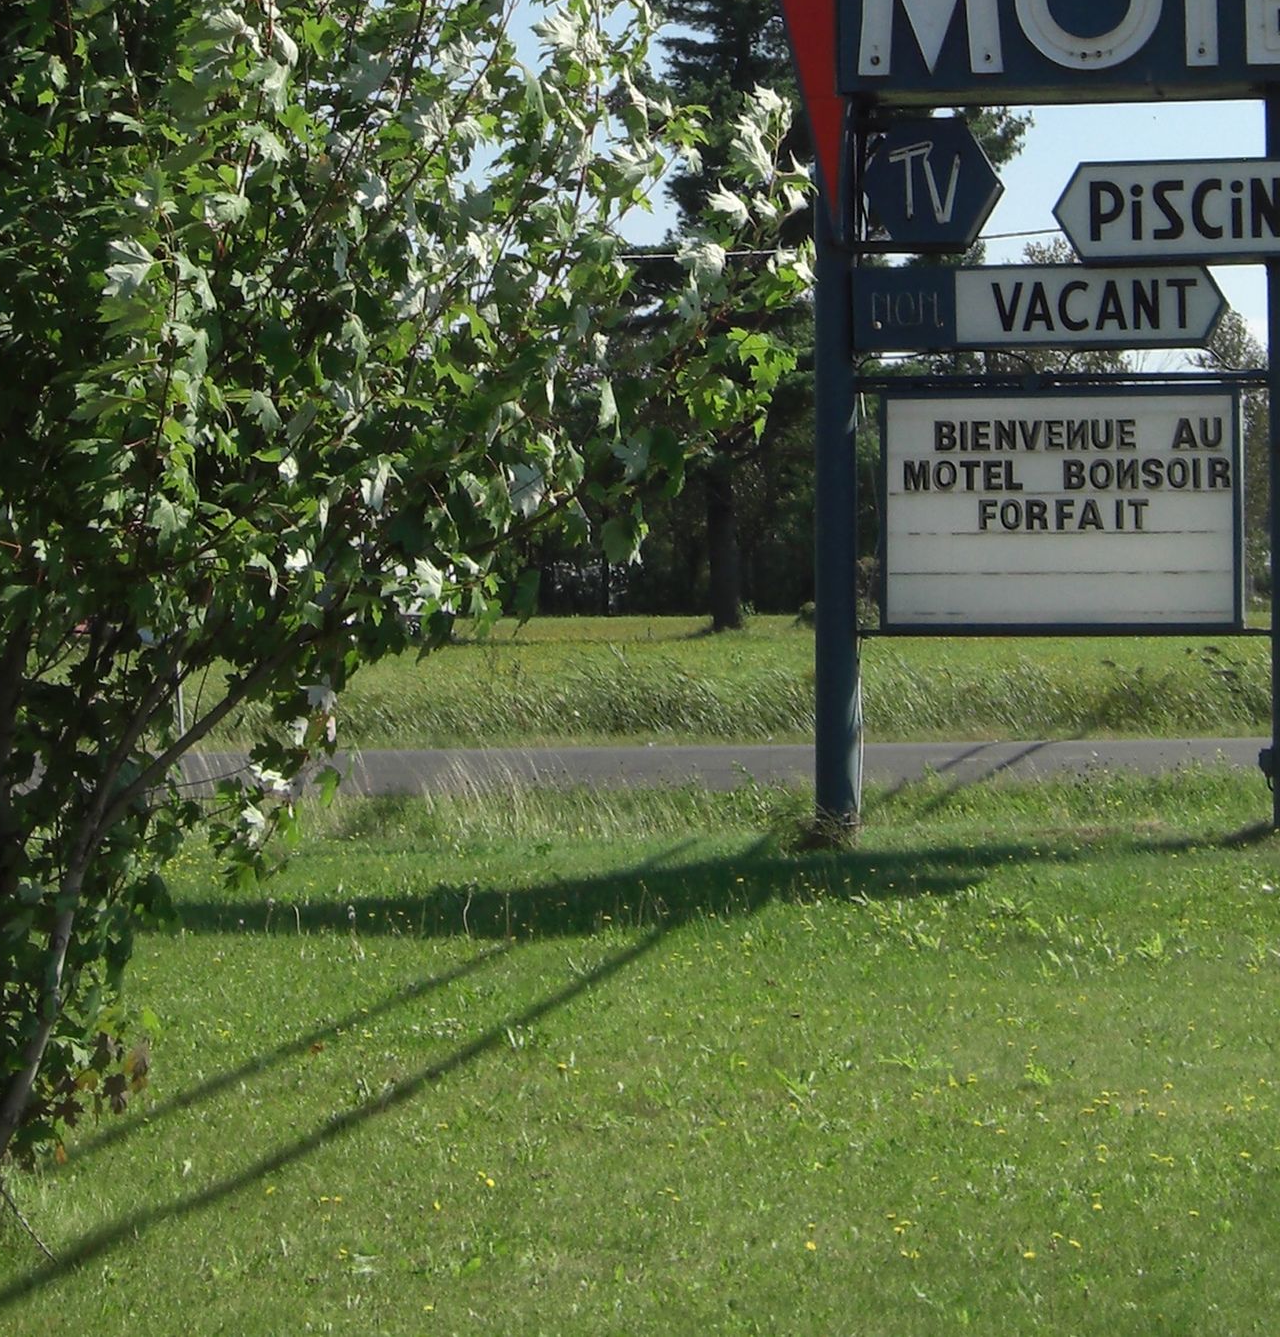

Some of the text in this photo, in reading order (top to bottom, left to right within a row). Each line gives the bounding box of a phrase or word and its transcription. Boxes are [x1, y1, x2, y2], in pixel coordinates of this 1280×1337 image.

[888, 140, 961, 224] TV
[991, 277, 1199, 333] VACANT
[933, 417, 1223, 453] BIENVENUE AU
[903, 457, 1232, 492] MOTEL BONSOIR
[978, 498, 1150, 531] FORFAIT
